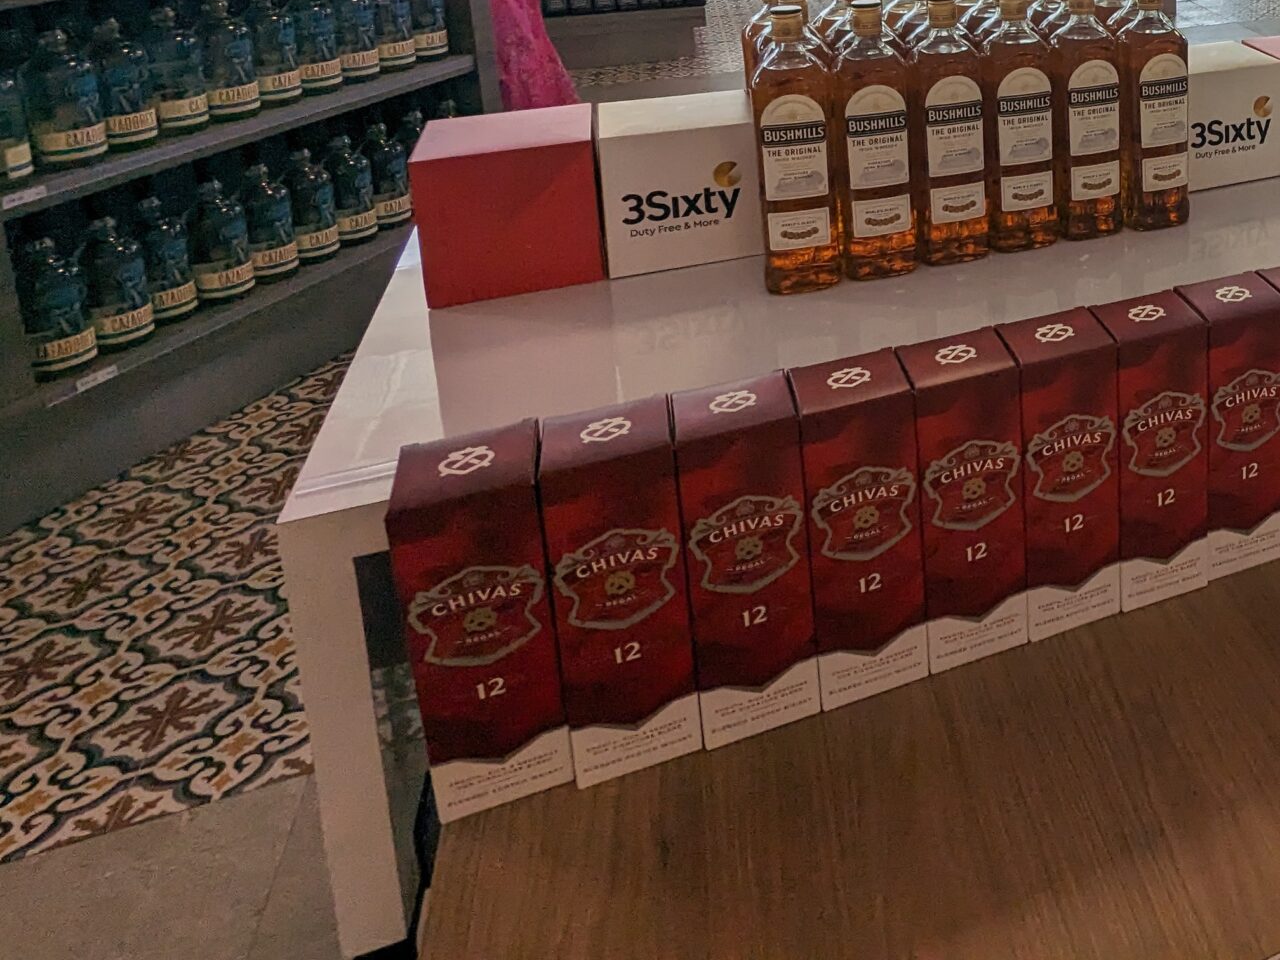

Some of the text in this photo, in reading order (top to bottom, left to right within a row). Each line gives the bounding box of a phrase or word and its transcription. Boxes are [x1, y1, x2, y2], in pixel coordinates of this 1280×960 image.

[1071, 88, 1118, 104] BUSHMILLS
[1142, 80, 1188, 97] BUSHMILLS
[928, 105, 982, 122] BUSHMILLS
[1000, 96, 1050, 112] BUSHMILLS
[1073, 106, 1116, 117] THE ORIGINAL
[1144, 98, 1186, 110] THE ORIGINAL
[848, 116, 906, 132] BUSHMILLS
[1002, 114, 1048, 126] THE ORIGINAL
[764, 126, 824, 142] BUSHMILLS
[932, 128, 944, 136] THE
[948, 124, 980, 134] ORIGINAL
[1190, 117, 1272, 149] 3Sixty
[868, 134, 904, 146] ORIGINAL
[785, 146, 822, 156] ORIGINAL
[1196, 150, 1212, 160] Duty
[1214, 148, 1230, 156] Free
[1238, 144, 1256, 152] More
[621, 188, 741, 225] 3Sixty
[630, 218, 720, 238] Duty Free & More
[1225, 386, 1277, 408] CHIVAS
[1138, 409, 1193, 432] CHIVAS
[1042, 432, 1102, 456] CHIVAS
[940, 458, 1004, 484] CHIVAS
[1241, 462, 1258, 480] 12
[830, 484, 898, 512] CHIVAS
[1157, 488, 1176, 507] 12
[709, 514, 784, 543] CHIVAS
[1064, 514, 1084, 532] 12
[966, 542, 988, 562] 12
[576, 547, 658, 578] CHIVAS
[859, 573, 882, 593] 12
[432, 583, 520, 616] CHIVAS
[742, 606, 768, 627] 12
[614, 642, 642, 664] 12
[476, 678, 506, 700] 12
